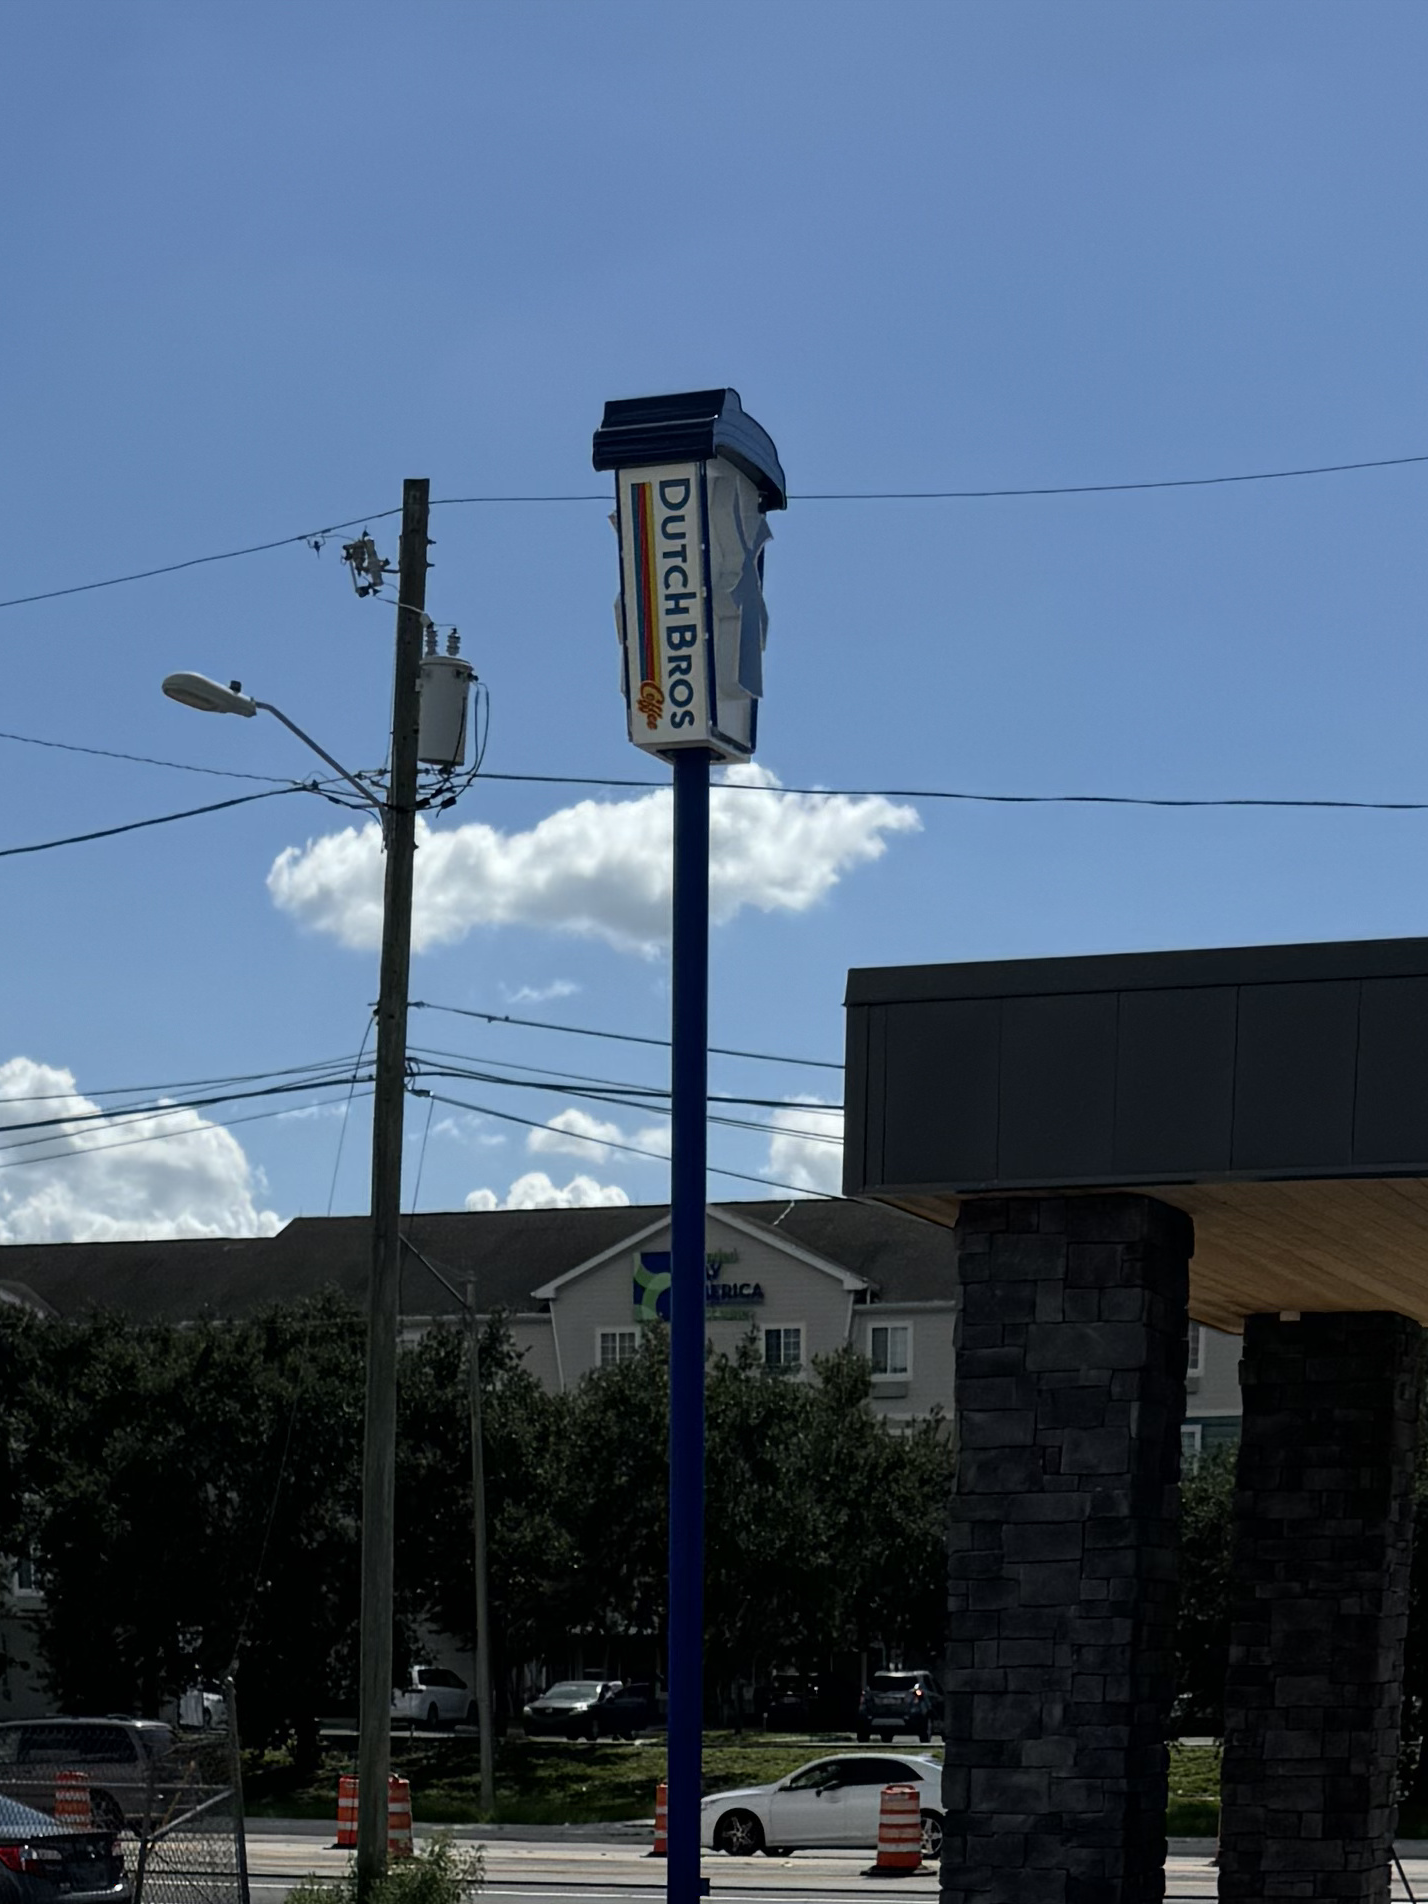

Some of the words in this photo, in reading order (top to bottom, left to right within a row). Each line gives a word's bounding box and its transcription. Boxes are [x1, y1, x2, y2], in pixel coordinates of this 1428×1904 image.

[659, 478, 697, 616] DUTCH
[637, 680, 665, 731] Coffee
[667, 624, 696, 730] BROS
